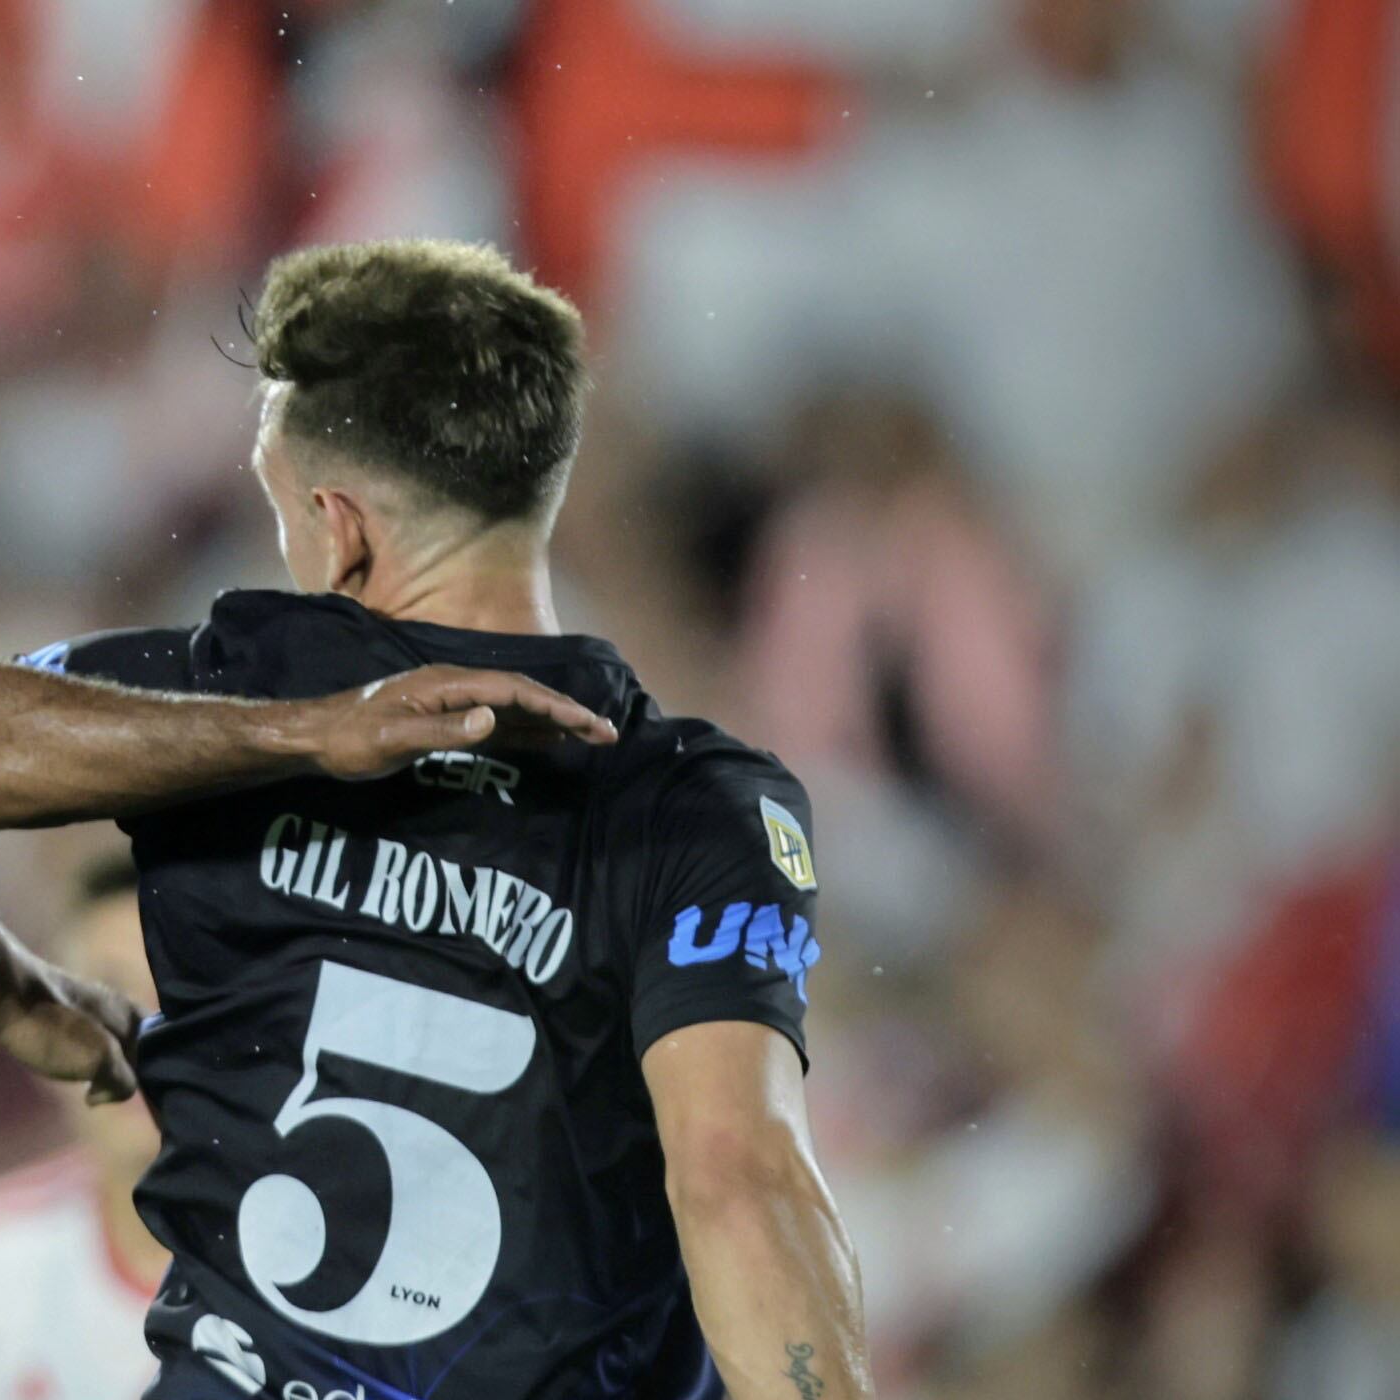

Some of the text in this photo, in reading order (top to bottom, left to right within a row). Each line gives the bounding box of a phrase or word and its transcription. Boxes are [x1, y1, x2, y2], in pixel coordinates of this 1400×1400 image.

[259, 813, 574, 985] GIL ROMERO
[238, 959, 537, 1346] 5
[390, 1284, 442, 1310] LYON
